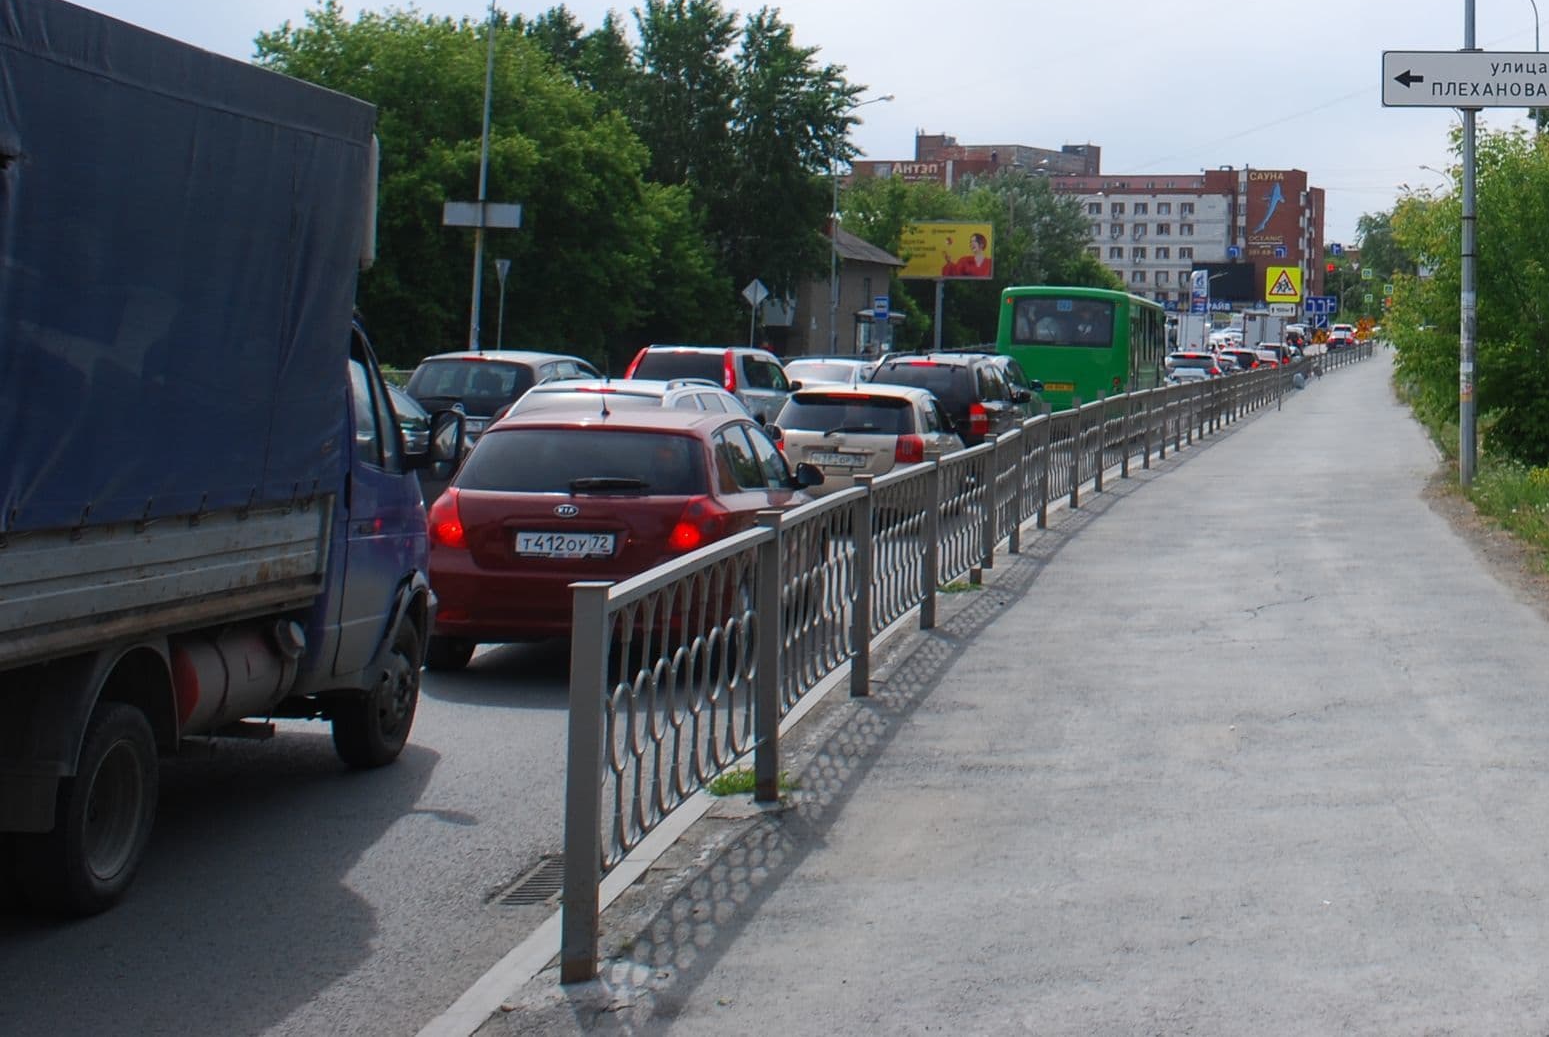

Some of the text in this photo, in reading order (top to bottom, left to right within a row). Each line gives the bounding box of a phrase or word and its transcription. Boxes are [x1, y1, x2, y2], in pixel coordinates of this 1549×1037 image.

[1491, 63, 1548, 76] улица
[1432, 82, 1548, 97] ПЛЕХАНОВА
[1250, 172, 1284, 181] САУНА
